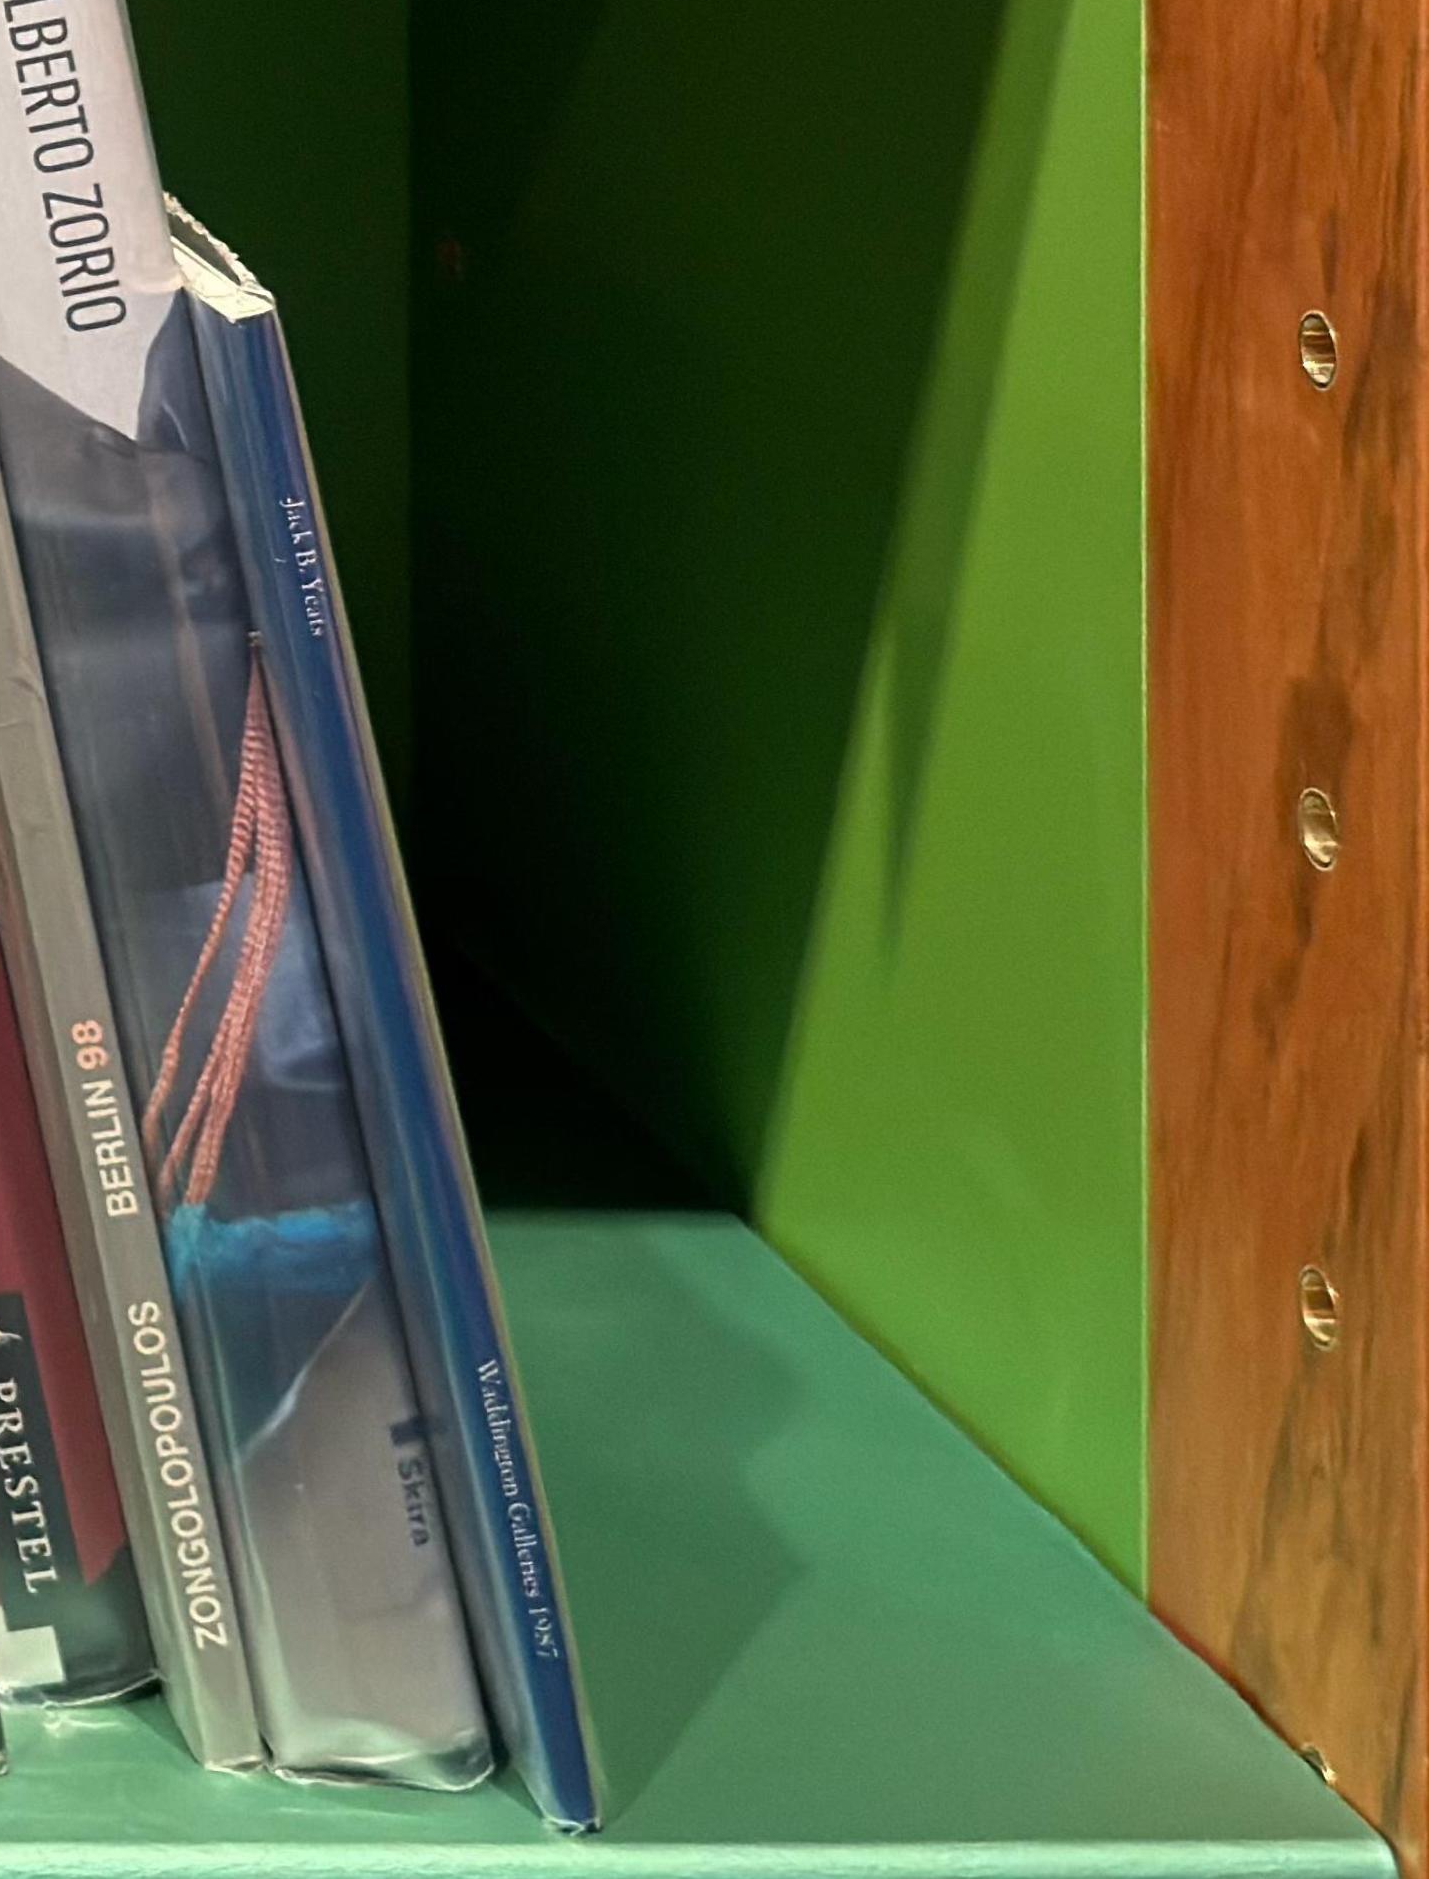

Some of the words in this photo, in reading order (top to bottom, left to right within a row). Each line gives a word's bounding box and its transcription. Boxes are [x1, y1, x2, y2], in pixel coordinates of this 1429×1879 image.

[42, 181, 128, 334] ZORIO
[70, 1019, 108, 1071] 98
[94, 1079, 140, 1218] BERLIN
[126, 1299, 229, 1650] ZONGOLOPOULOS
